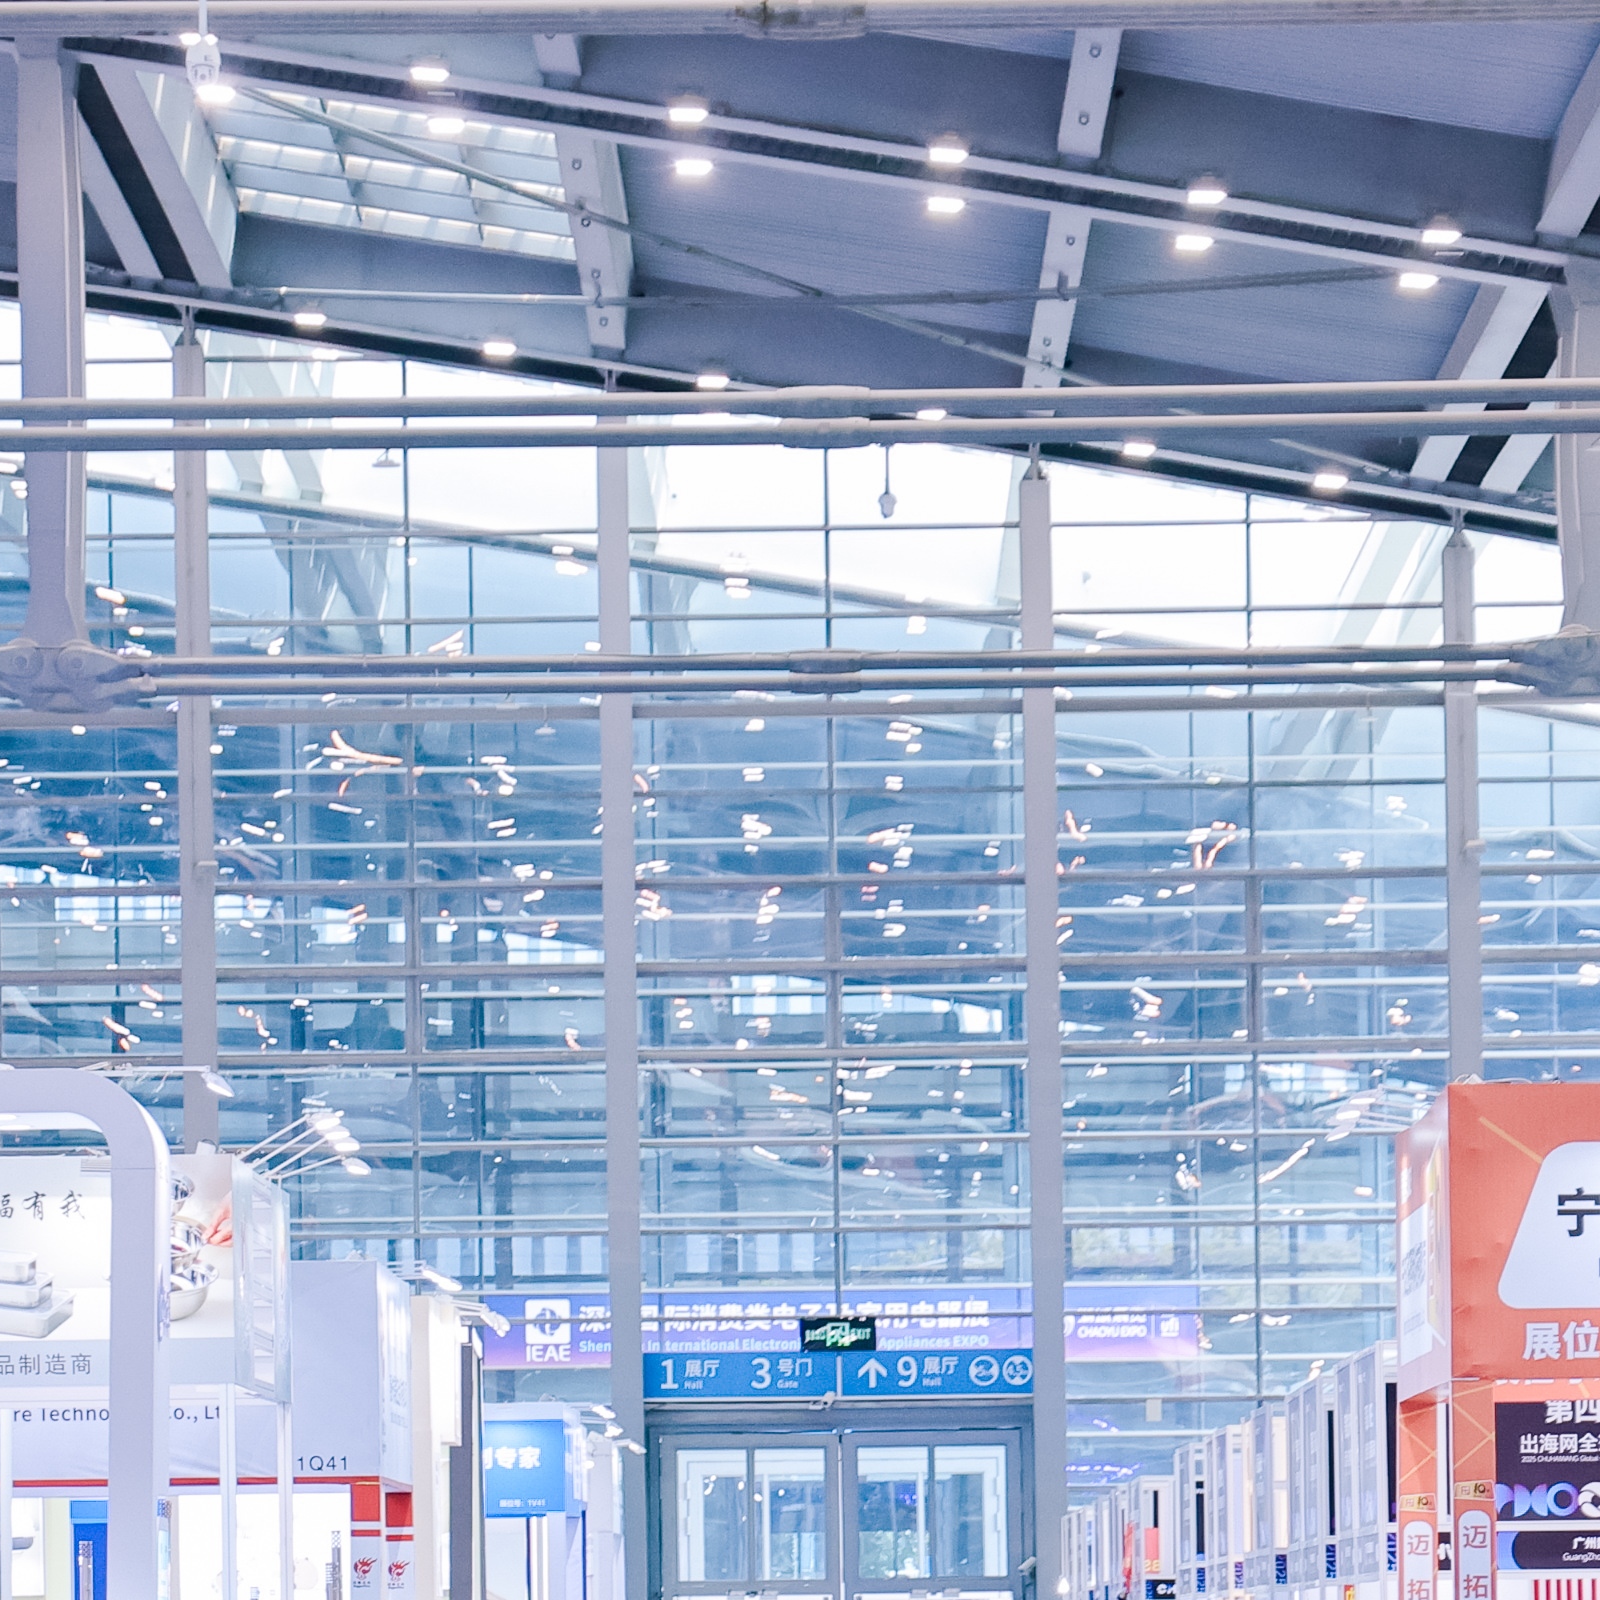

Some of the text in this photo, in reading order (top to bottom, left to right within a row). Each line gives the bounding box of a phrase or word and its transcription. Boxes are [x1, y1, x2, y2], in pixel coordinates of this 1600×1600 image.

[579, 1339, 611, 1352] Shen
[742, 1337, 802, 1351] Electroni
[879, 1337, 950, 1352] Appliances
[953, 1335, 988, 1348] EXPO
[526, 1345, 570, 1362] IEAE
[660, 1358, 679, 1390] 1
[684, 1359, 719, 1377] 展厅
[750, 1358, 772, 1390] 3
[777, 1358, 812, 1377] 号门
[896, 1356, 918, 1388] 9
[923, 1356, 959, 1375] 展厅
[777, 1380, 800, 1390] Gate
[42, 1406, 110, 1422] Techno
[169, 1406, 198, 1423] o.,
[205, 1405, 220, 1421] Lt
[297, 1455, 349, 1472] 1Q41
